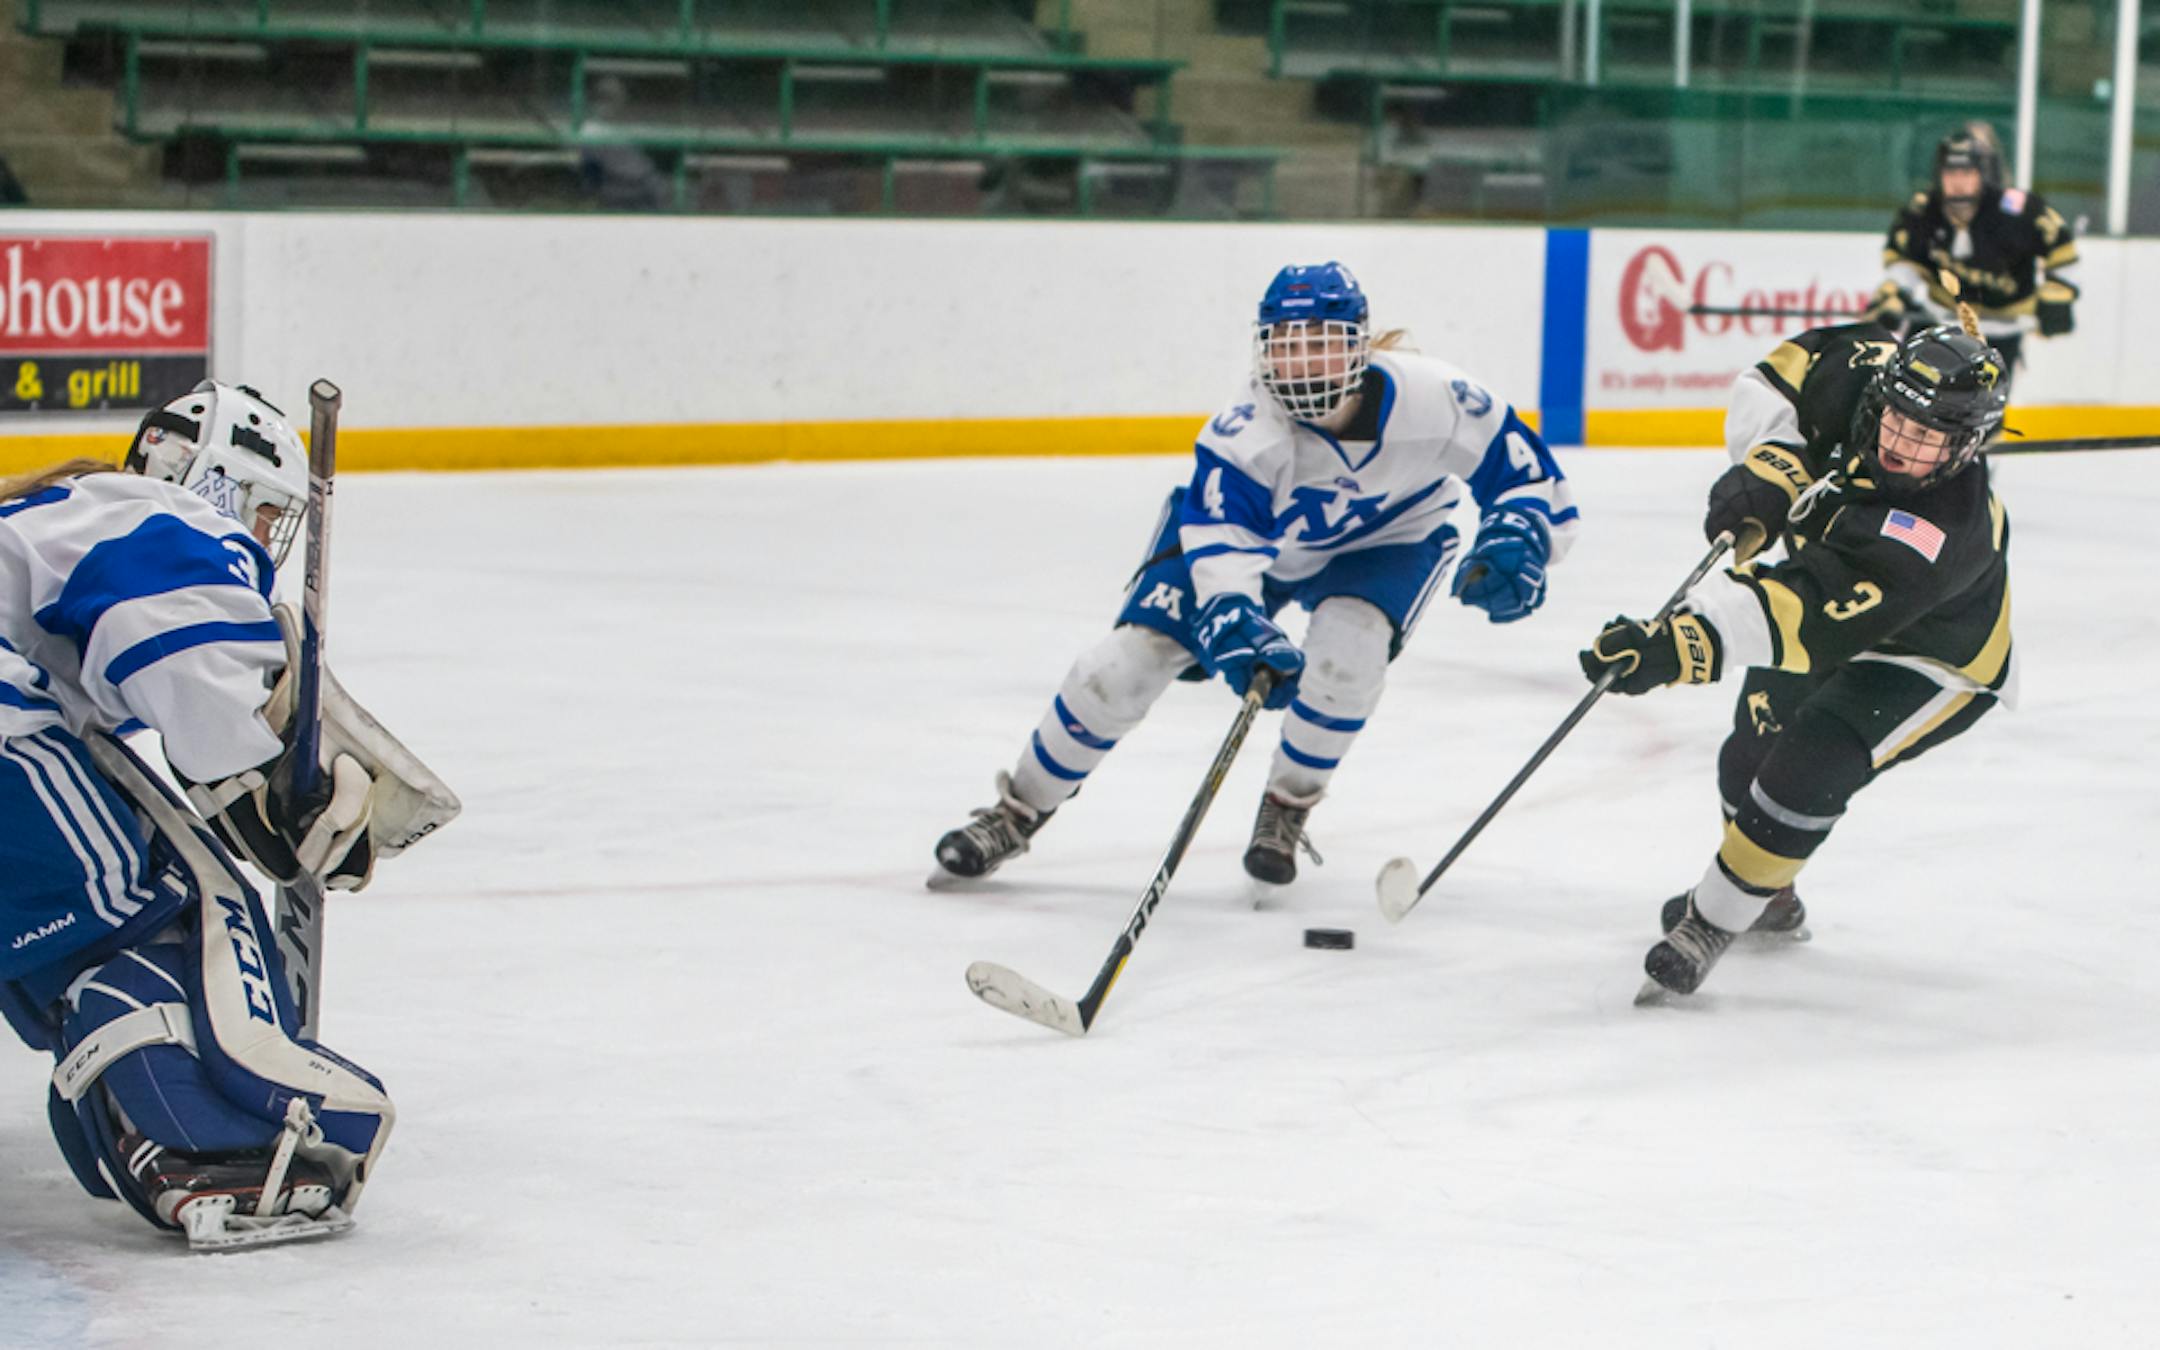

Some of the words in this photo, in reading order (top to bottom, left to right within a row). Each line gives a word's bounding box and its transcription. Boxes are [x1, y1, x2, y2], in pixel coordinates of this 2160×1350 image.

[0, 244, 184, 338] house
[15, 361, 43, 400] &
[68, 361, 139, 408] grill
[1894, 381, 1932, 407] CCM
[1506, 431, 1543, 479] 4
[1203, 467, 1225, 520] 4
[1824, 581, 1883, 621] 3
[11, 911, 77, 949] JAMM
[214, 895, 275, 1026] CCM
[66, 1043, 100, 1083] CCM
